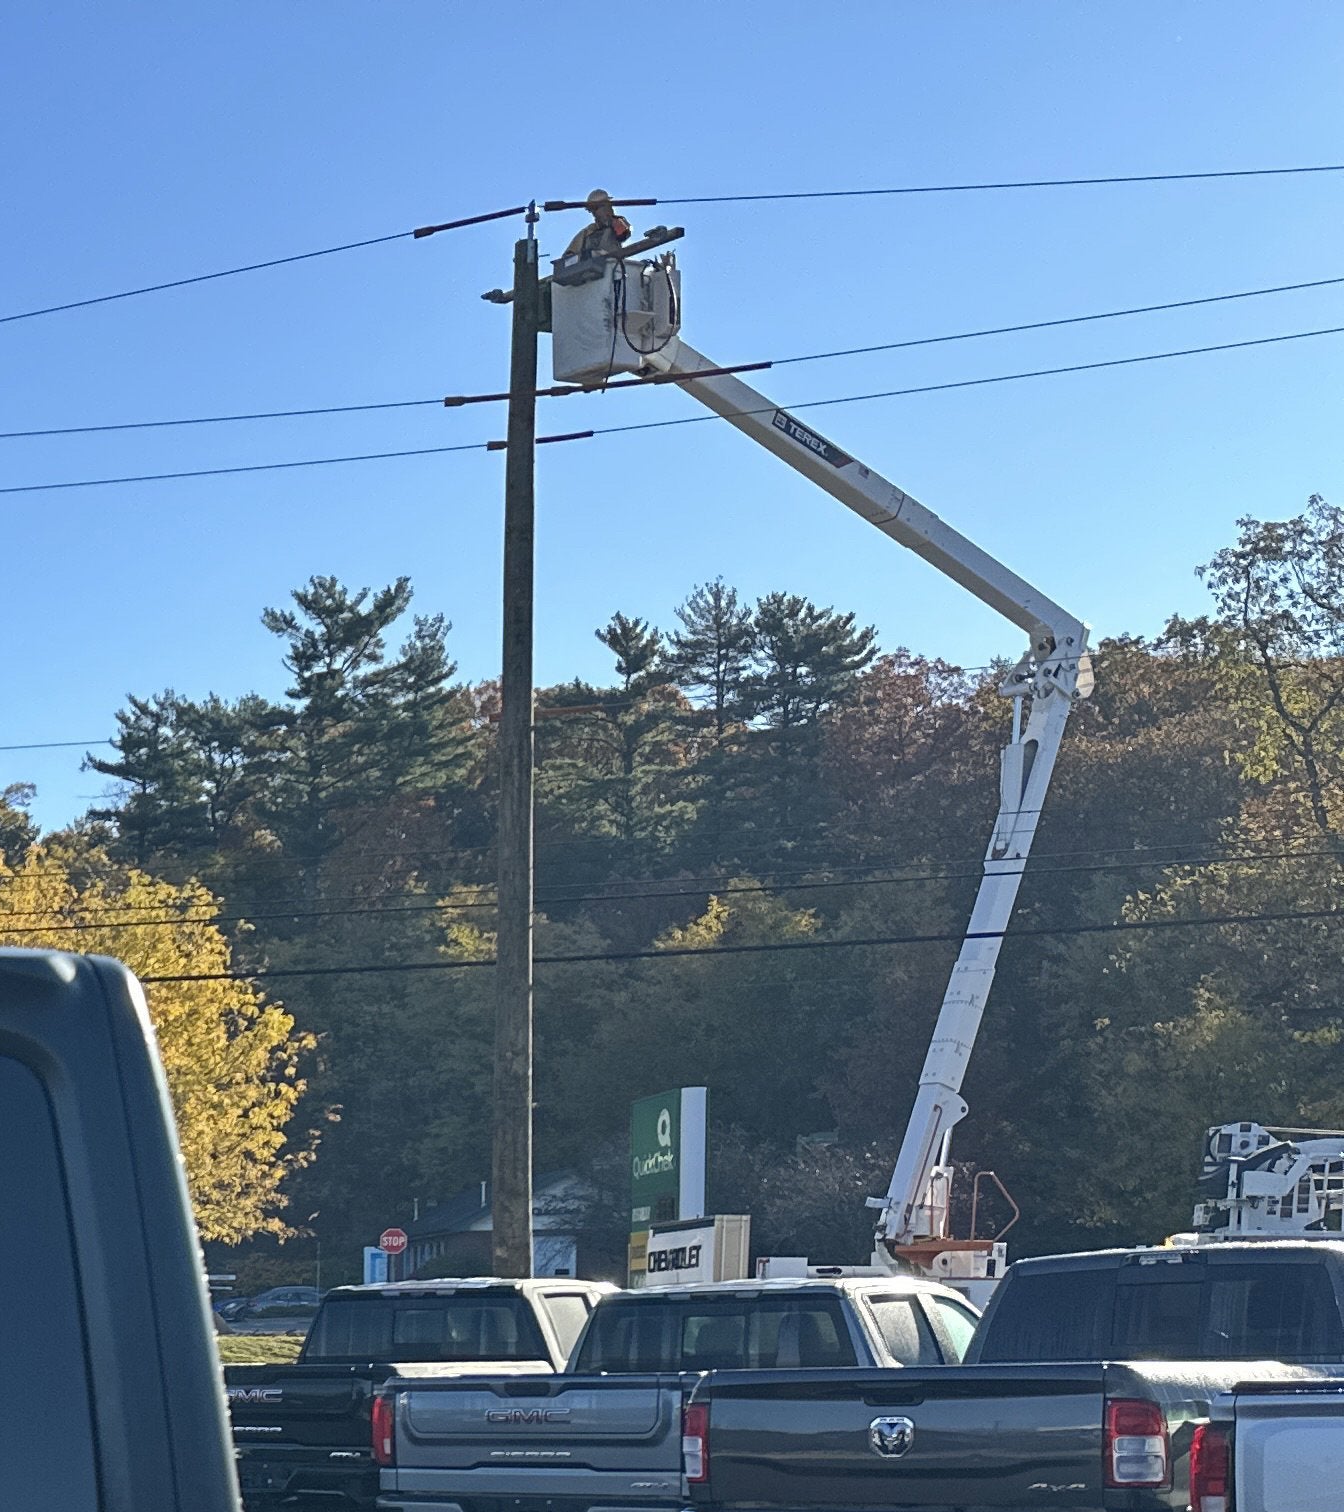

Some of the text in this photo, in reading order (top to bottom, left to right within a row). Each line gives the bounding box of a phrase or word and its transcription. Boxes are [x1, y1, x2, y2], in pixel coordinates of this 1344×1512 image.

[789, 421, 828, 456] TEREX
[382, 1236, 405, 1247] STOP
[484, 1408, 572, 1425] GMC
